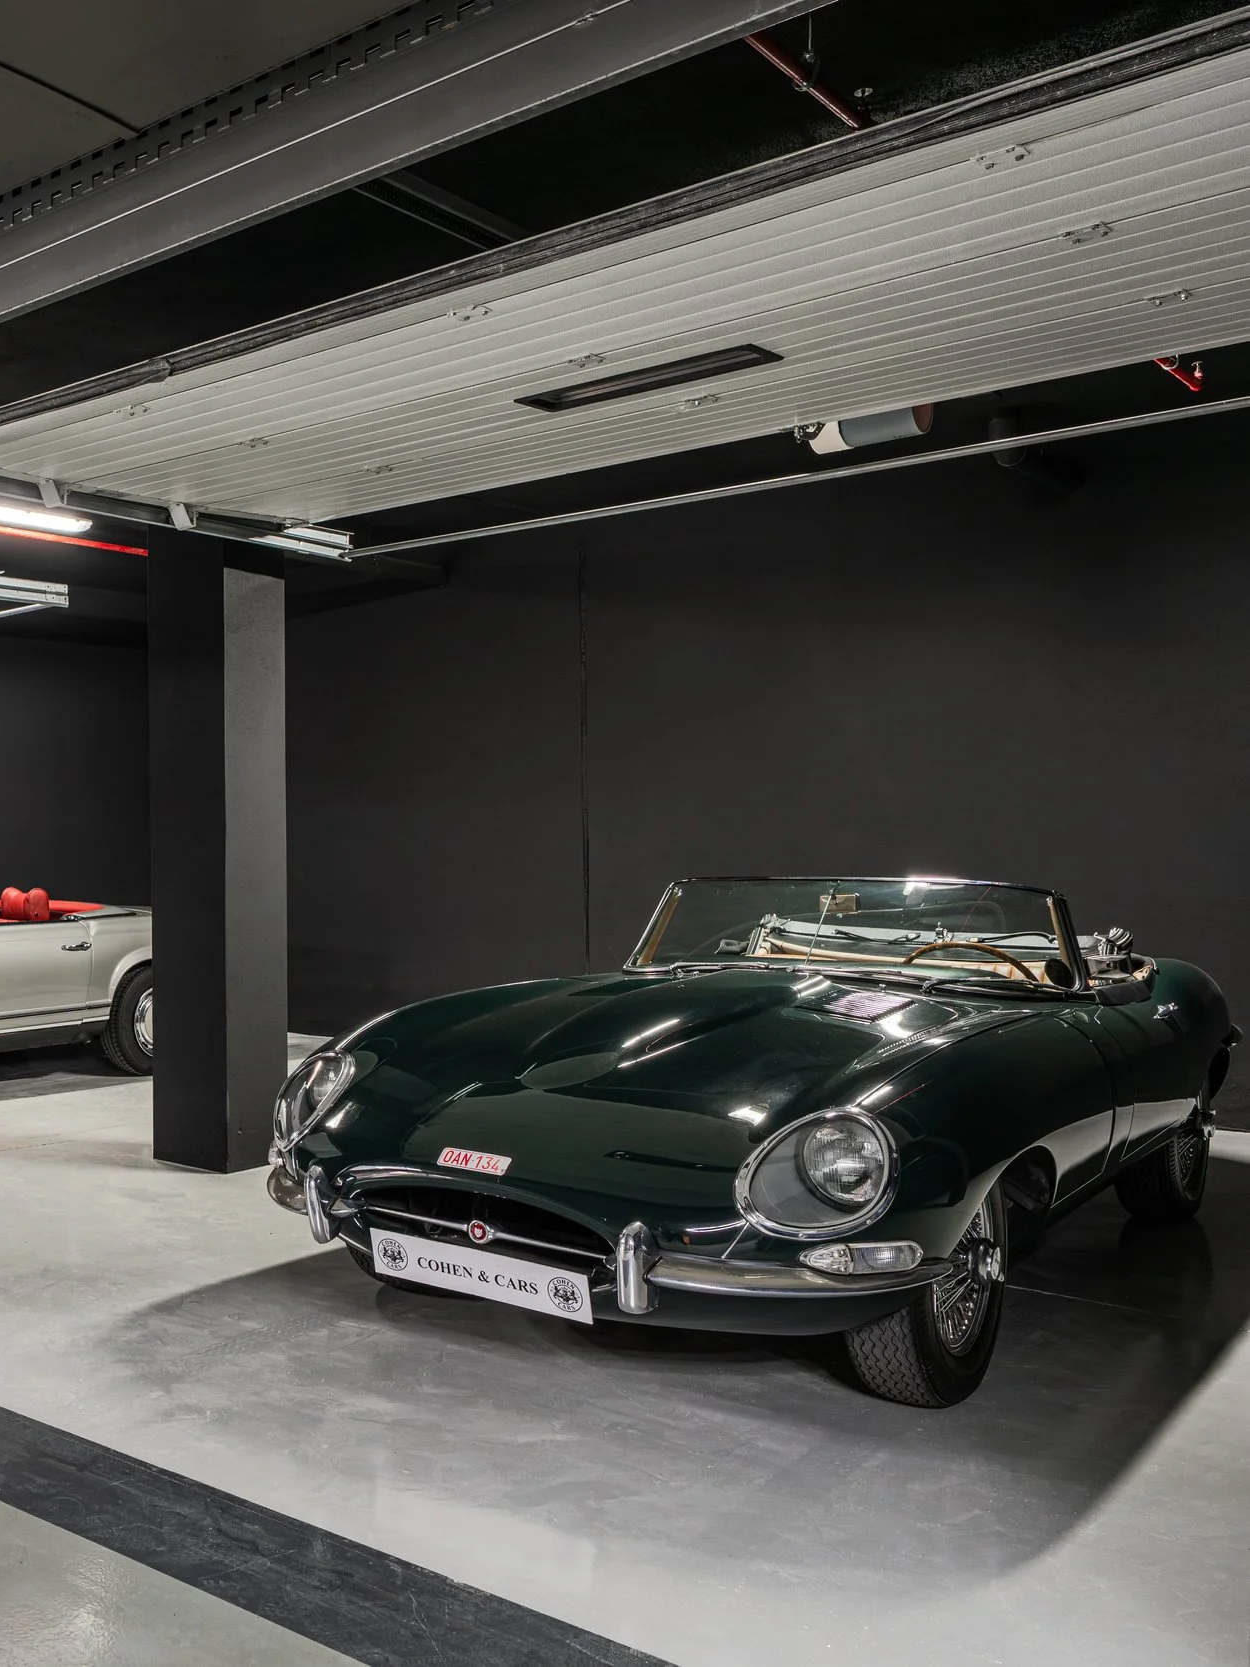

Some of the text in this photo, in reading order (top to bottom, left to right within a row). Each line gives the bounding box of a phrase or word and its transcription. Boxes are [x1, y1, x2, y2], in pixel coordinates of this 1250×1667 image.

[381, 1240, 401, 1250] COHEN
[386, 1261, 402, 1269] CARS
[417, 1256, 538, 1295] COHEN & CARS
[552, 1280, 575, 1290] COHEN
[557, 1302, 576, 1310] CARS
